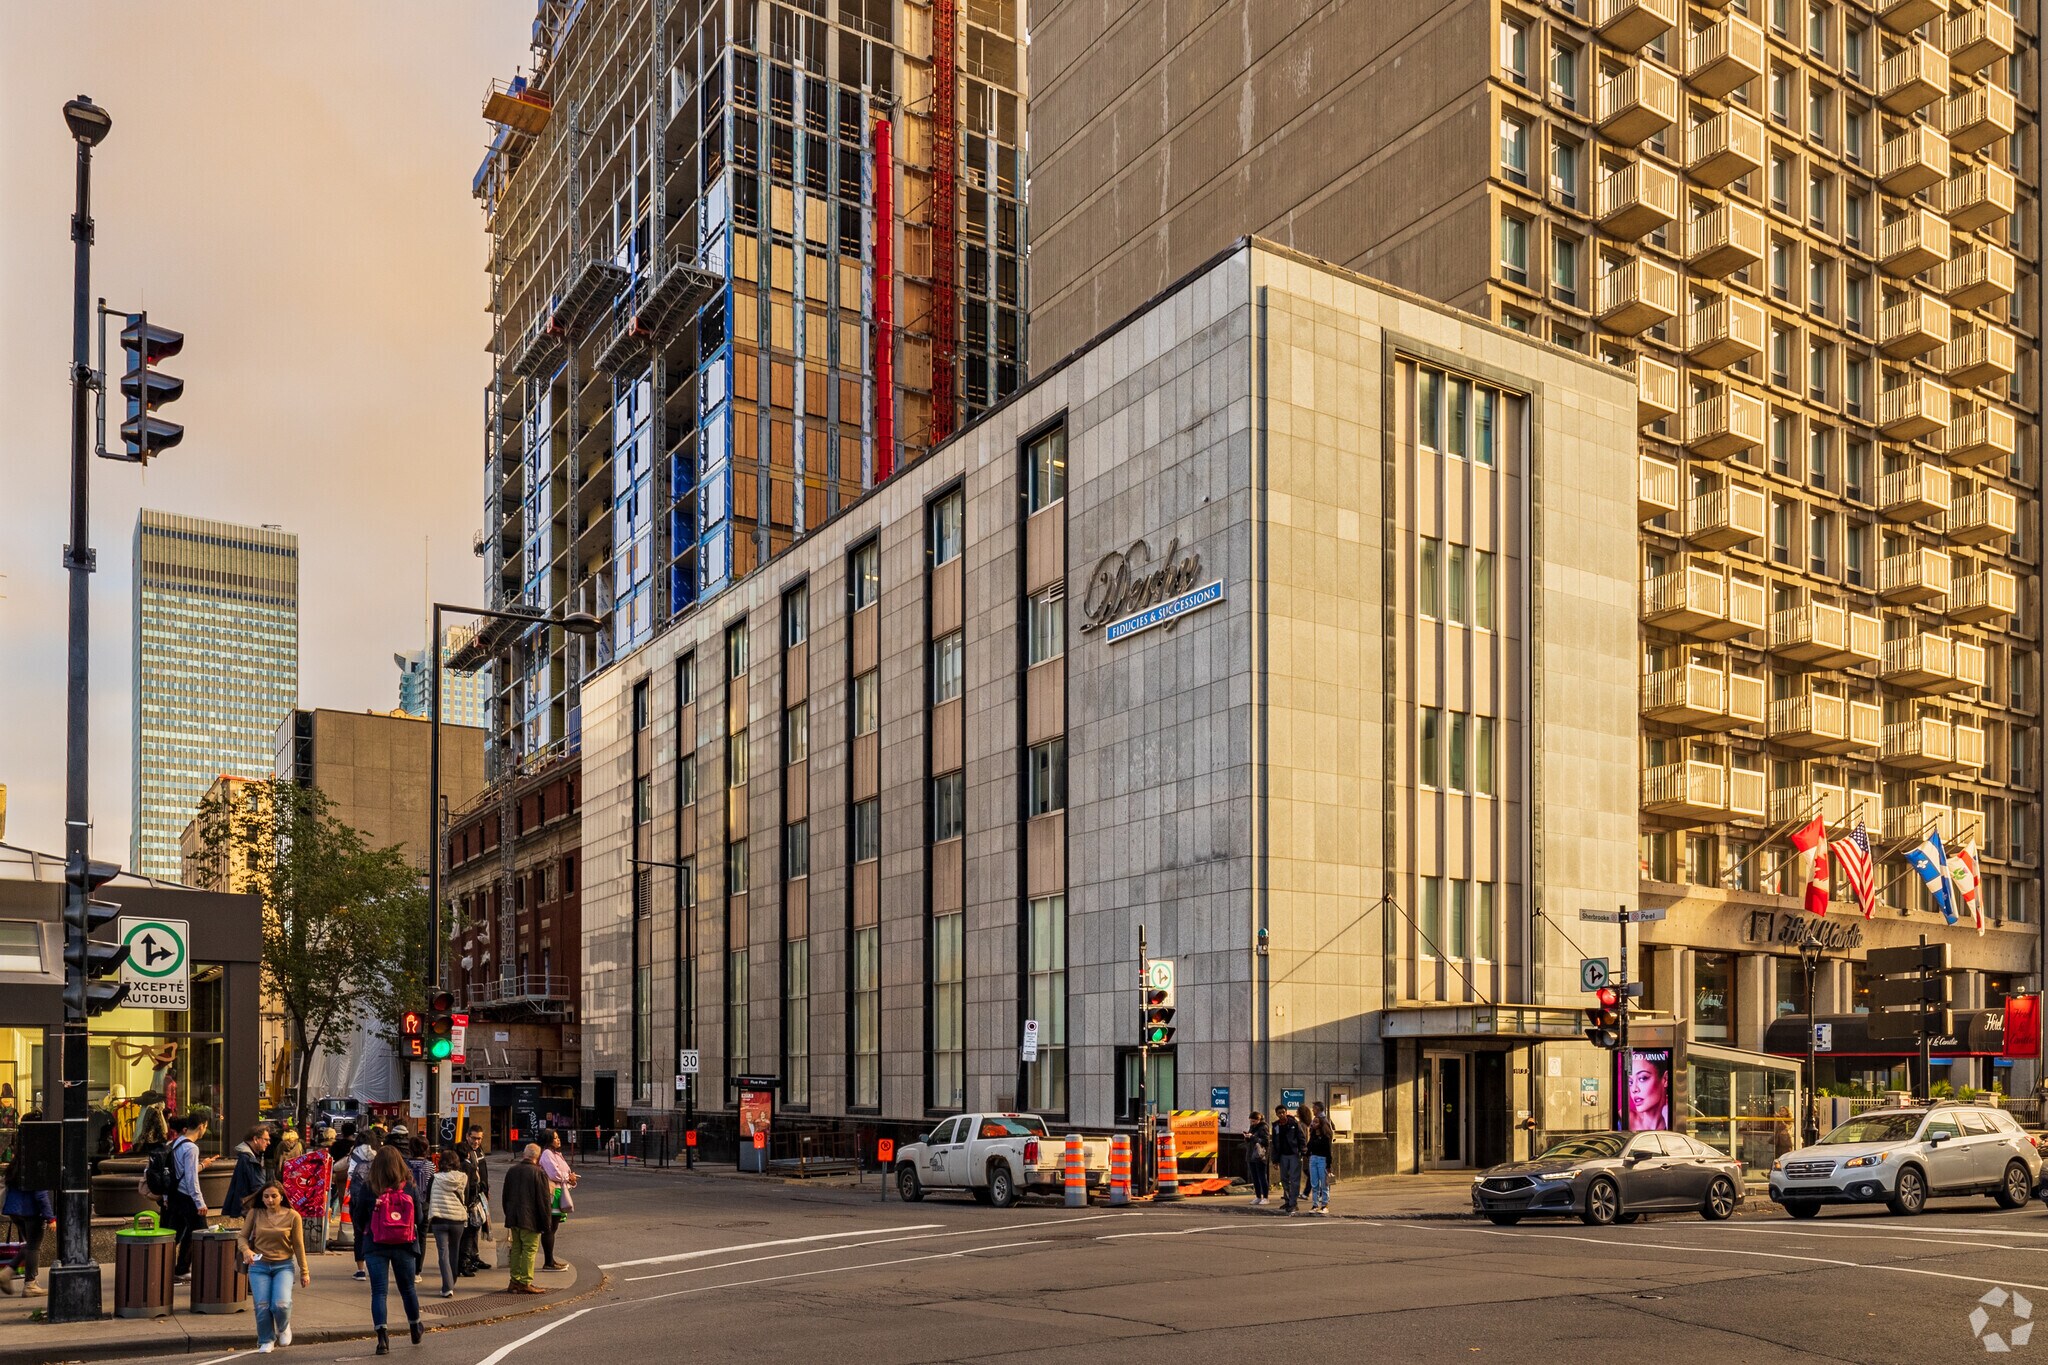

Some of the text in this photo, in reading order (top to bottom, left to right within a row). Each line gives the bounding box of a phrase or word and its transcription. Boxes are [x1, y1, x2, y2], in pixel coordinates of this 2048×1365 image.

[1078, 537, 1202, 631] Derby
[1112, 586, 1216, 638] FIDUCIES & SUCCESSIONS
[1581, 912, 1610, 921] Sherbrooke
[1640, 912, 1656, 920] Peel
[122, 994, 186, 1005] AUTOBUS
[411, 1040, 422, 1055] 5
[682, 1055, 698, 1067] 30
[1644, 1053, 1666, 1061] ARMANI
[1287, 1100, 1300, 1108] GYM
